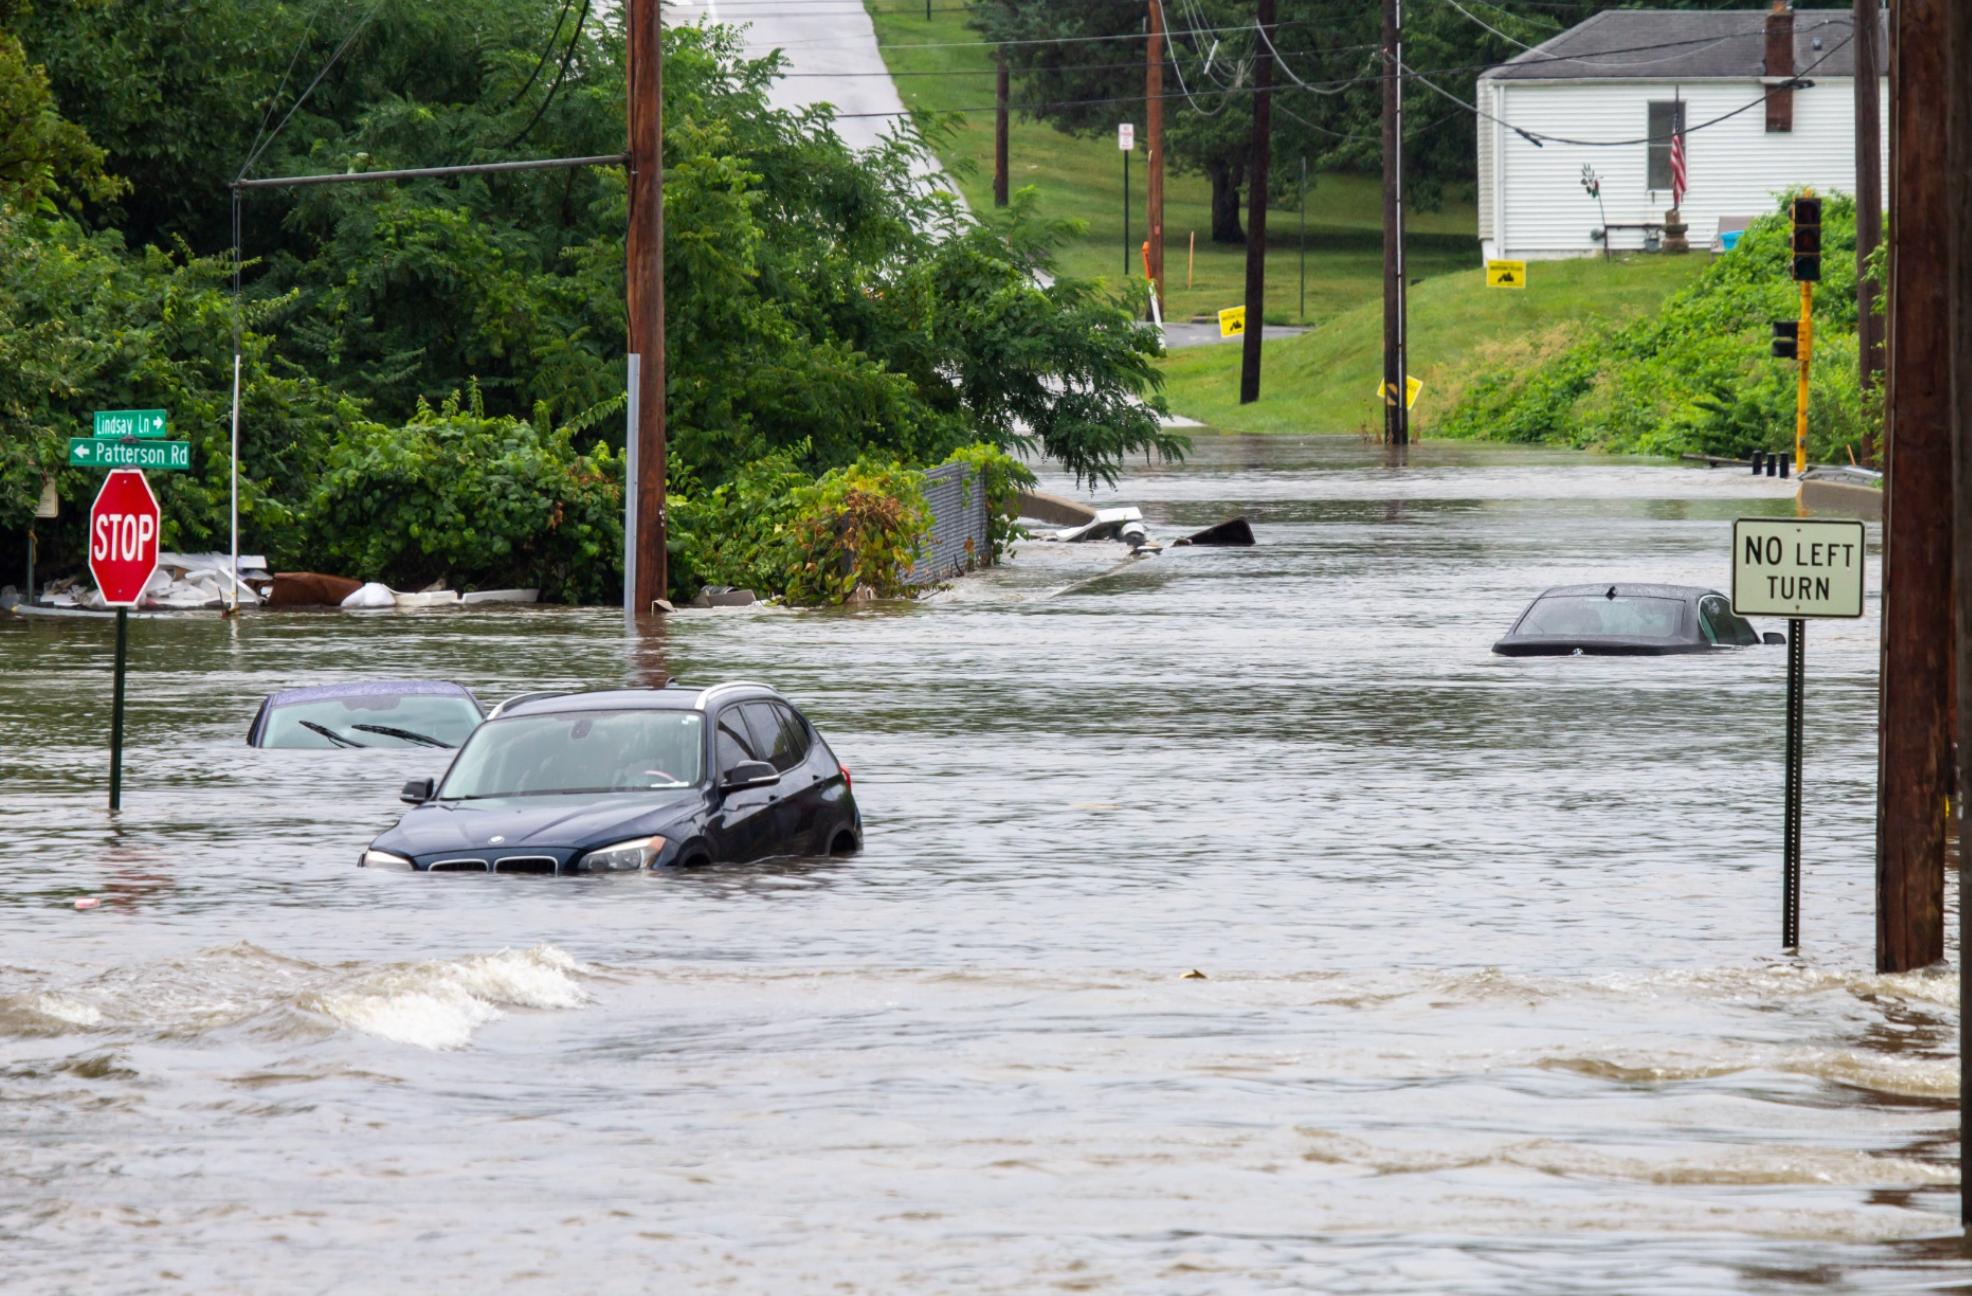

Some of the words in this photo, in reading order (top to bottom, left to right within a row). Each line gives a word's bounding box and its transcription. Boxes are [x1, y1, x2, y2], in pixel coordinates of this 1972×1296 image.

[96, 414, 133, 435] Lindsay
[138, 414, 150, 434] Ln
[96, 442, 165, 464] Patterson
[171, 444, 188, 465] Rd
[94, 513, 154, 562] STOP
[1745, 535, 1783, 566] NO
[1796, 542, 1854, 567] LEFT
[1766, 575, 1830, 600] TURN
